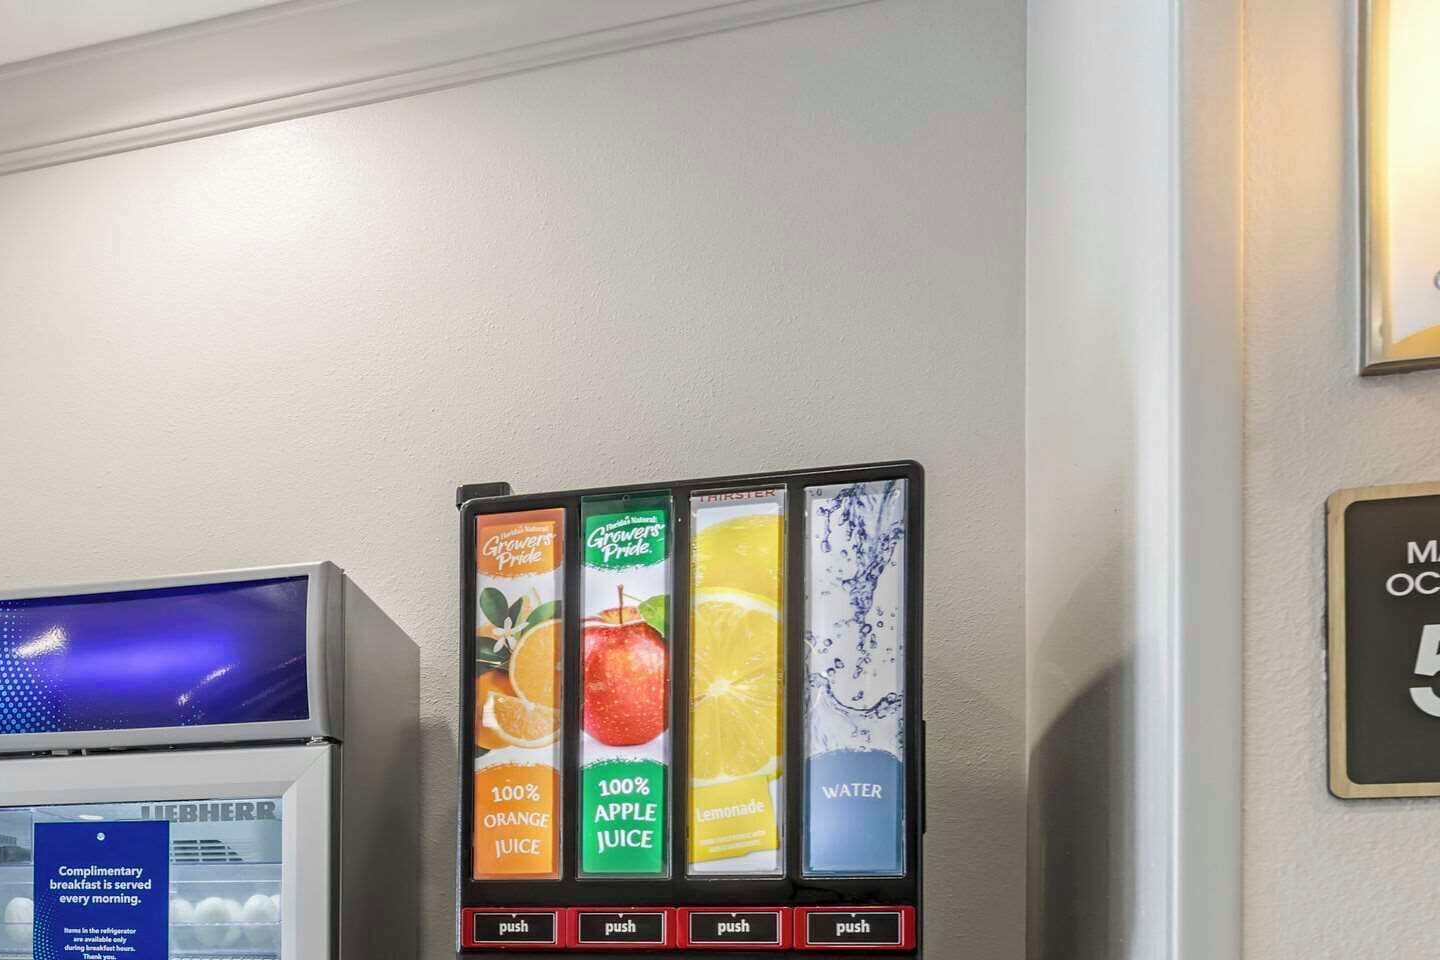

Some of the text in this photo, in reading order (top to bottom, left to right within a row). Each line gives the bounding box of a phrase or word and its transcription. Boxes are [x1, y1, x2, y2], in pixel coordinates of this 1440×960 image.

[1407, 540, 1440, 564] M
[491, 783, 541, 803] 100%
[598, 776, 651, 797] 100%
[821, 782, 882, 800] WATER
[594, 801, 658, 823] APPLE
[696, 799, 766, 823] Lemonade
[483, 811, 551, 829] ORANGE
[495, 837, 542, 859] JUICE
[596, 828, 654, 854] JUICE
[58, 865, 143, 879] Complimentary
[49, 879, 152, 890] breakfast is served
[59, 893, 142, 906] every morning.
[63, 927, 137, 936] Items in the refrigerator
[498, 920, 529, 936] push
[604, 920, 637, 936] push
[717, 920, 750, 936] push
[835, 920, 871, 936] push
[112, 936, 127, 944] only
[64, 945, 85, 953] during
